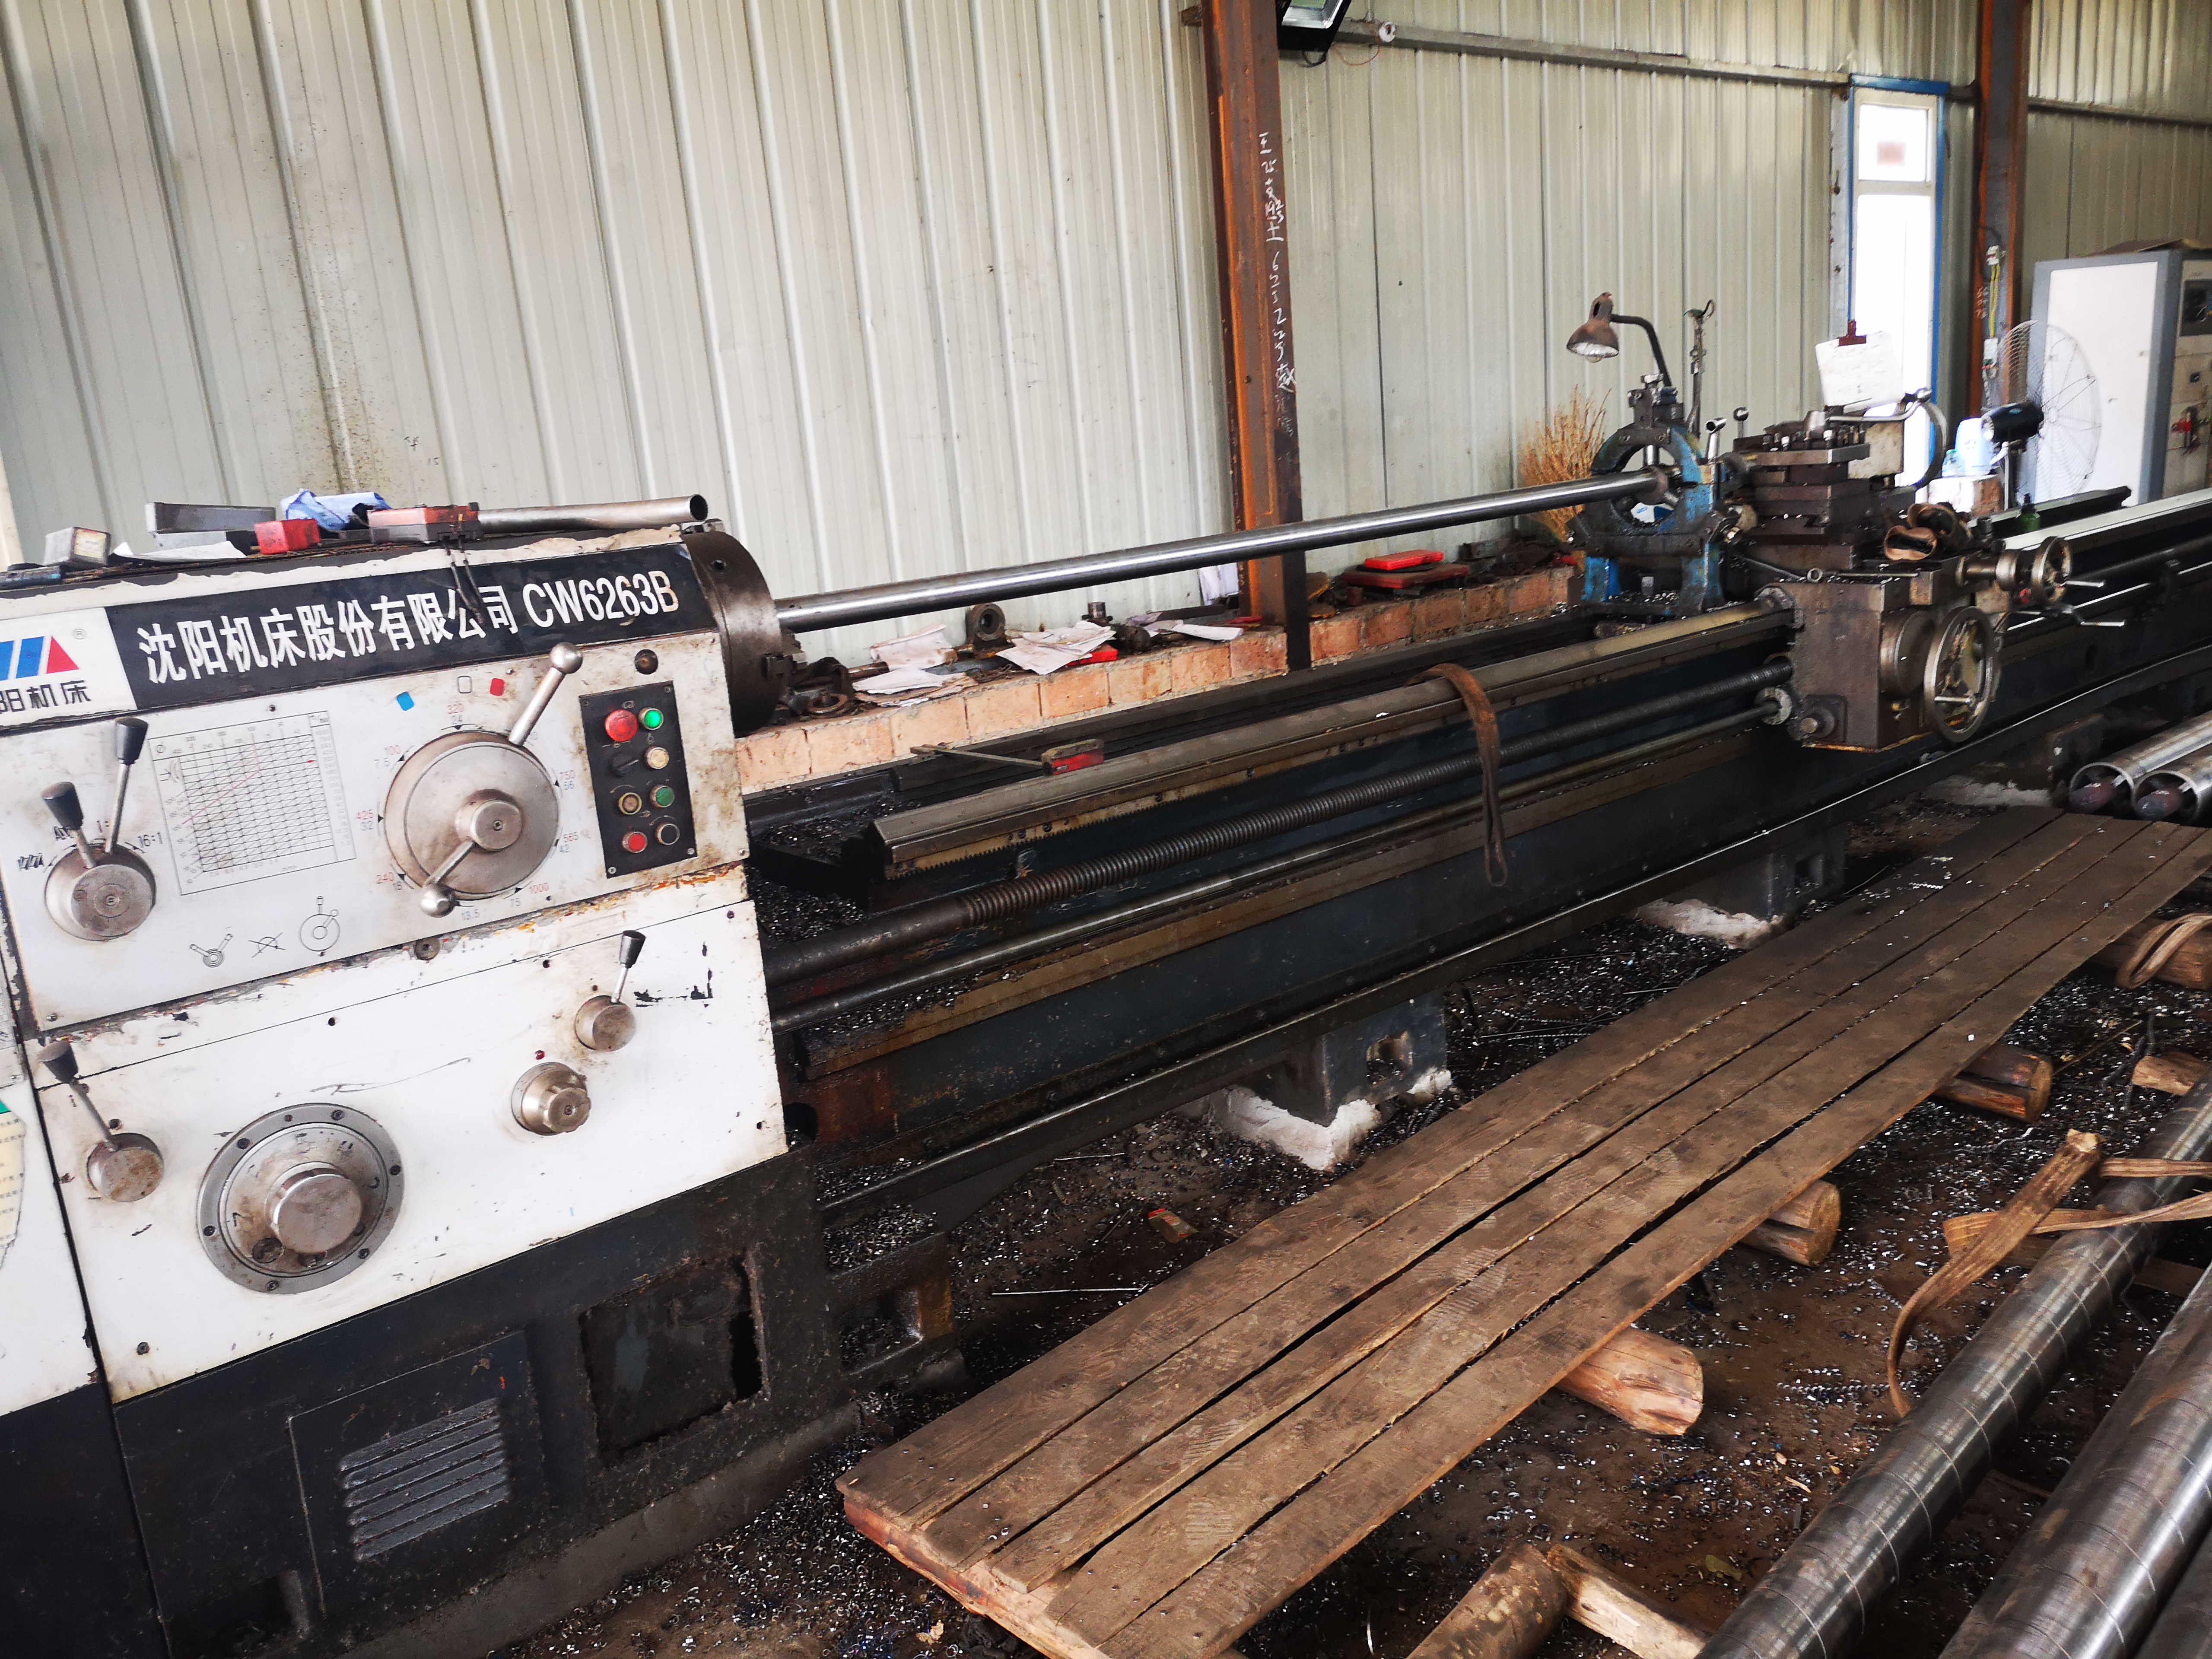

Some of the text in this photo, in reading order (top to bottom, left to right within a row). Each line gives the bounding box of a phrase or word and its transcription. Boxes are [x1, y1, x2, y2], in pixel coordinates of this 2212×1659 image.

[136, 570, 679, 684] 沈阳机床股份有限公司 CW6263B
[447, 703, 465, 714] 320
[452, 715, 463, 725] 24
[385, 745, 401, 755] 100
[559, 770, 575, 780] 750
[356, 809, 375, 820] 425
[96, 820, 110, 833] 1:
[361, 820, 373, 831] 32
[138, 832, 163, 848] 16:1
[563, 831, 579, 843] 565
[559, 844, 570, 853] 42
[376, 872, 394, 884] 240
[529, 883, 550, 893] 1000
[510, 898, 521, 907] 75
